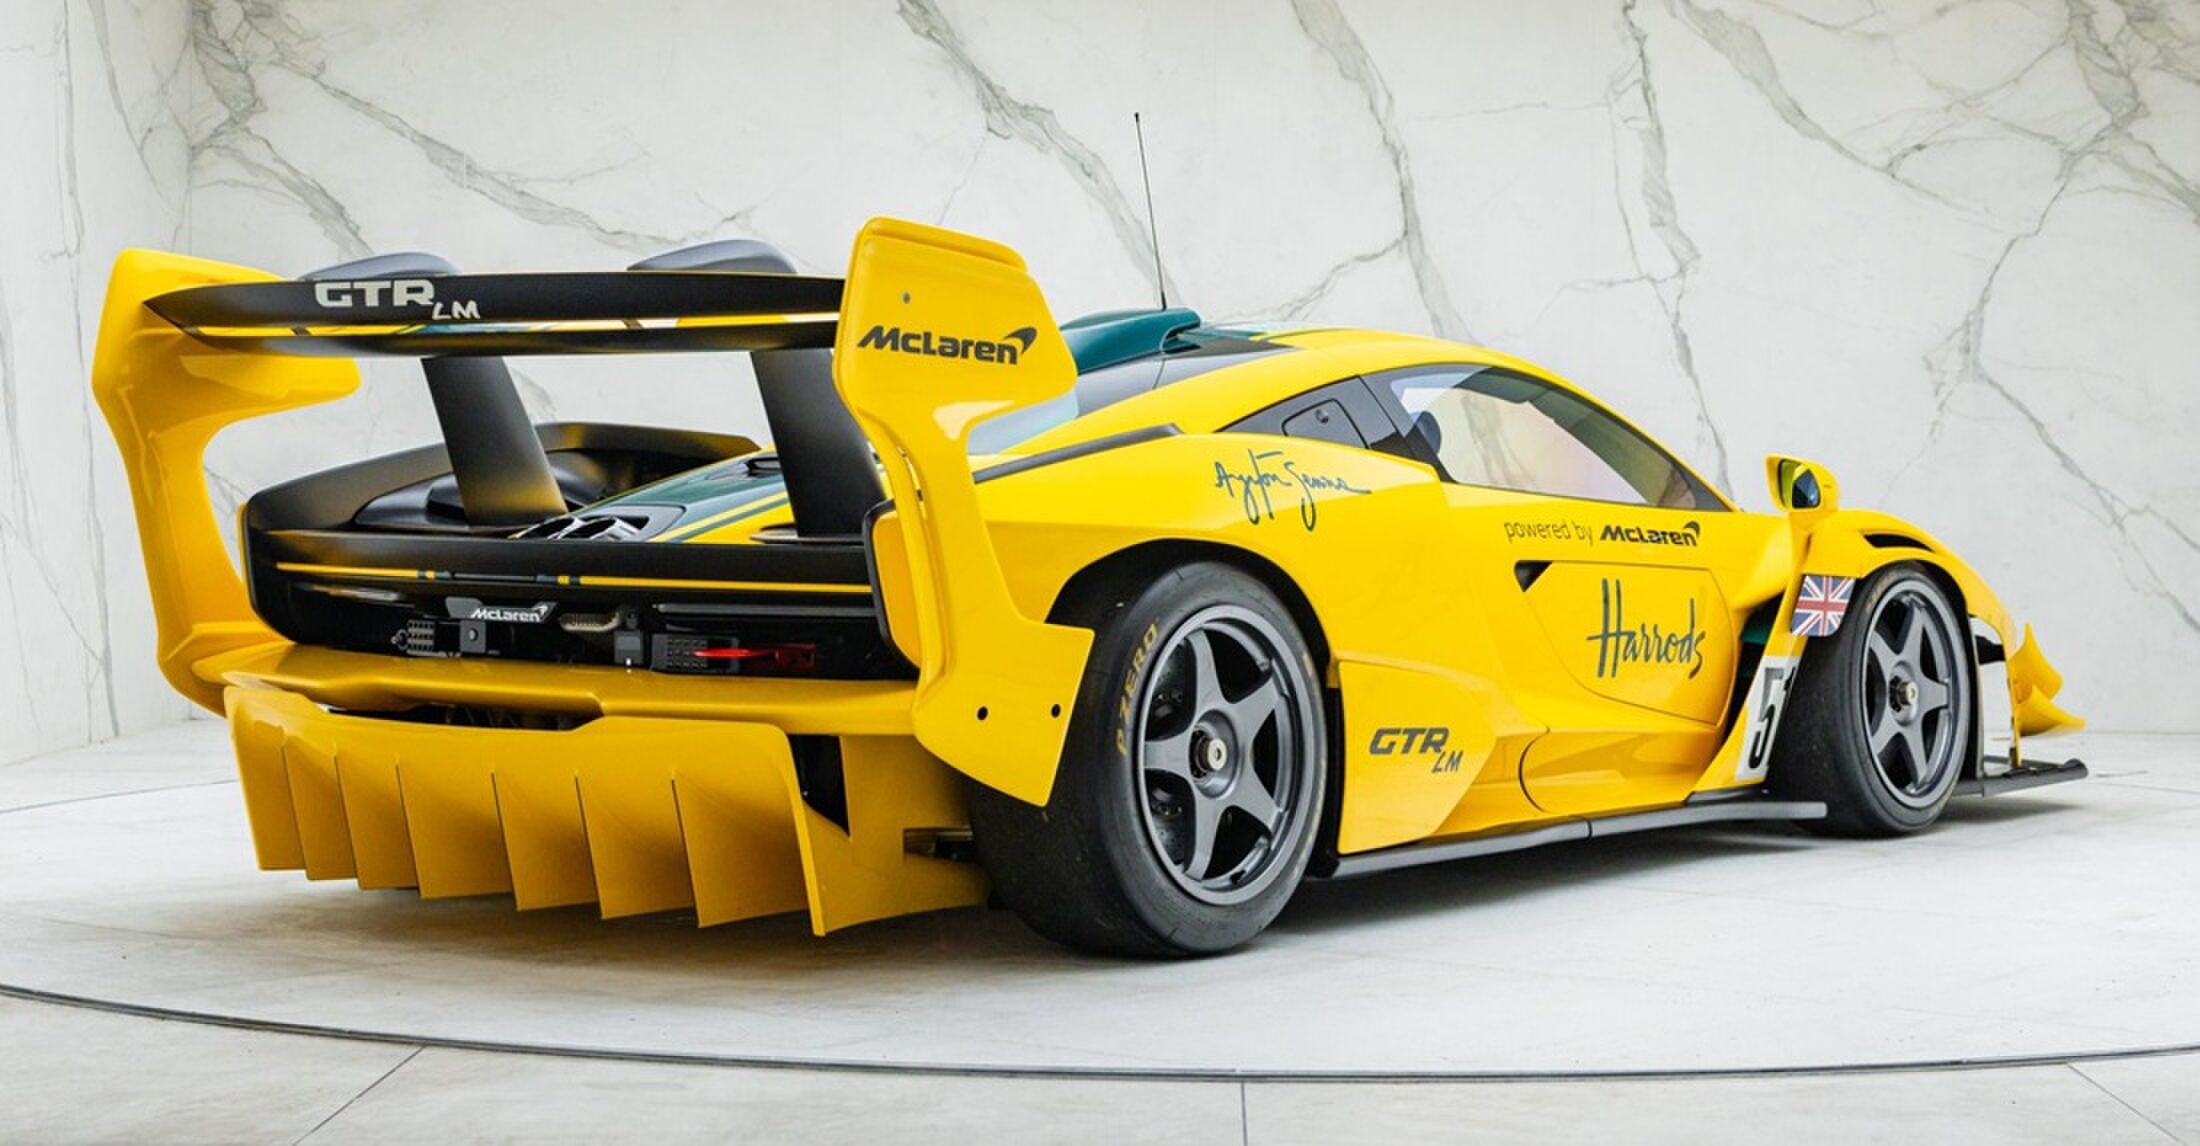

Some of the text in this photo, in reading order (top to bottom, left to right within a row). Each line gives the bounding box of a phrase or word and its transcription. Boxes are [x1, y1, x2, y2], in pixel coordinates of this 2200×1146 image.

[315, 279, 481, 320] GTR LM
[857, 325, 1018, 365] McLaren
[1503, 519, 1697, 547] powered by McLaren
[469, 608, 541, 623] McLaren
[1586, 578, 1706, 680] Harrods
[1369, 727, 1464, 773] GTR LM
